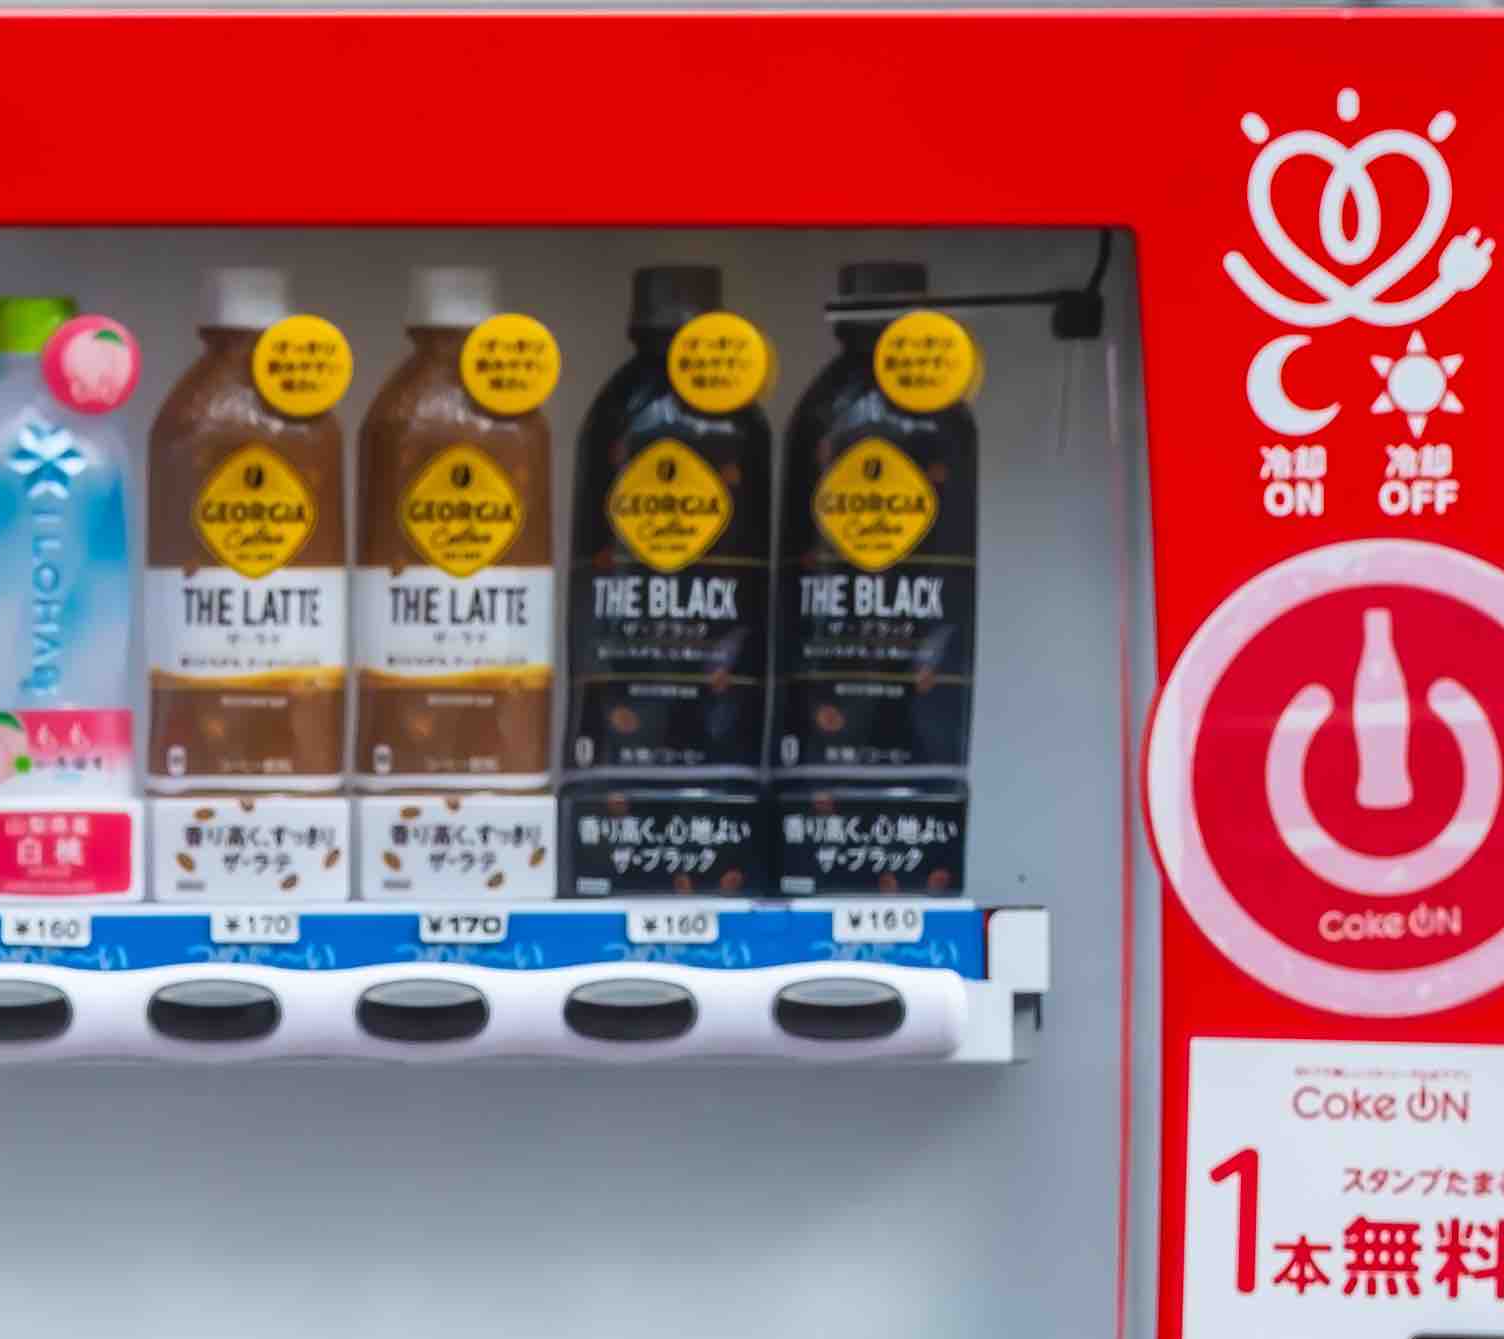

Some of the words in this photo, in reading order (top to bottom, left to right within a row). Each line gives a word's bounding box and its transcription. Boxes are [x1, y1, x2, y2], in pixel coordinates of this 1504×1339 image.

[1259, 445, 1327, 480] 冷却
[1385, 443, 1453, 479] 冷却
[201, 501, 306, 525] GEORGIA
[408, 500, 513, 524] GEORGIA
[612, 494, 721, 518] GEORGIA
[819, 492, 927, 516] GEORGIA
[1263, 481, 1325, 516] ON
[1378, 480, 1459, 515] OFF
[181, 586, 233, 627] THE
[241, 586, 322, 628] LATTE
[389, 586, 441, 626] THE
[449, 586, 528, 627] LATTE
[593, 576, 641, 620] THE
[648, 575, 738, 620] BLACK
[799, 575, 848, 619] THE
[853, 574, 944, 619] BLACK
[426, 915, 502, 934] ¥170
[1318, 908, 1407, 941] Coke
[1292, 1086, 1396, 1120] Coke
[1407, 1080, 1470, 1122] ON
